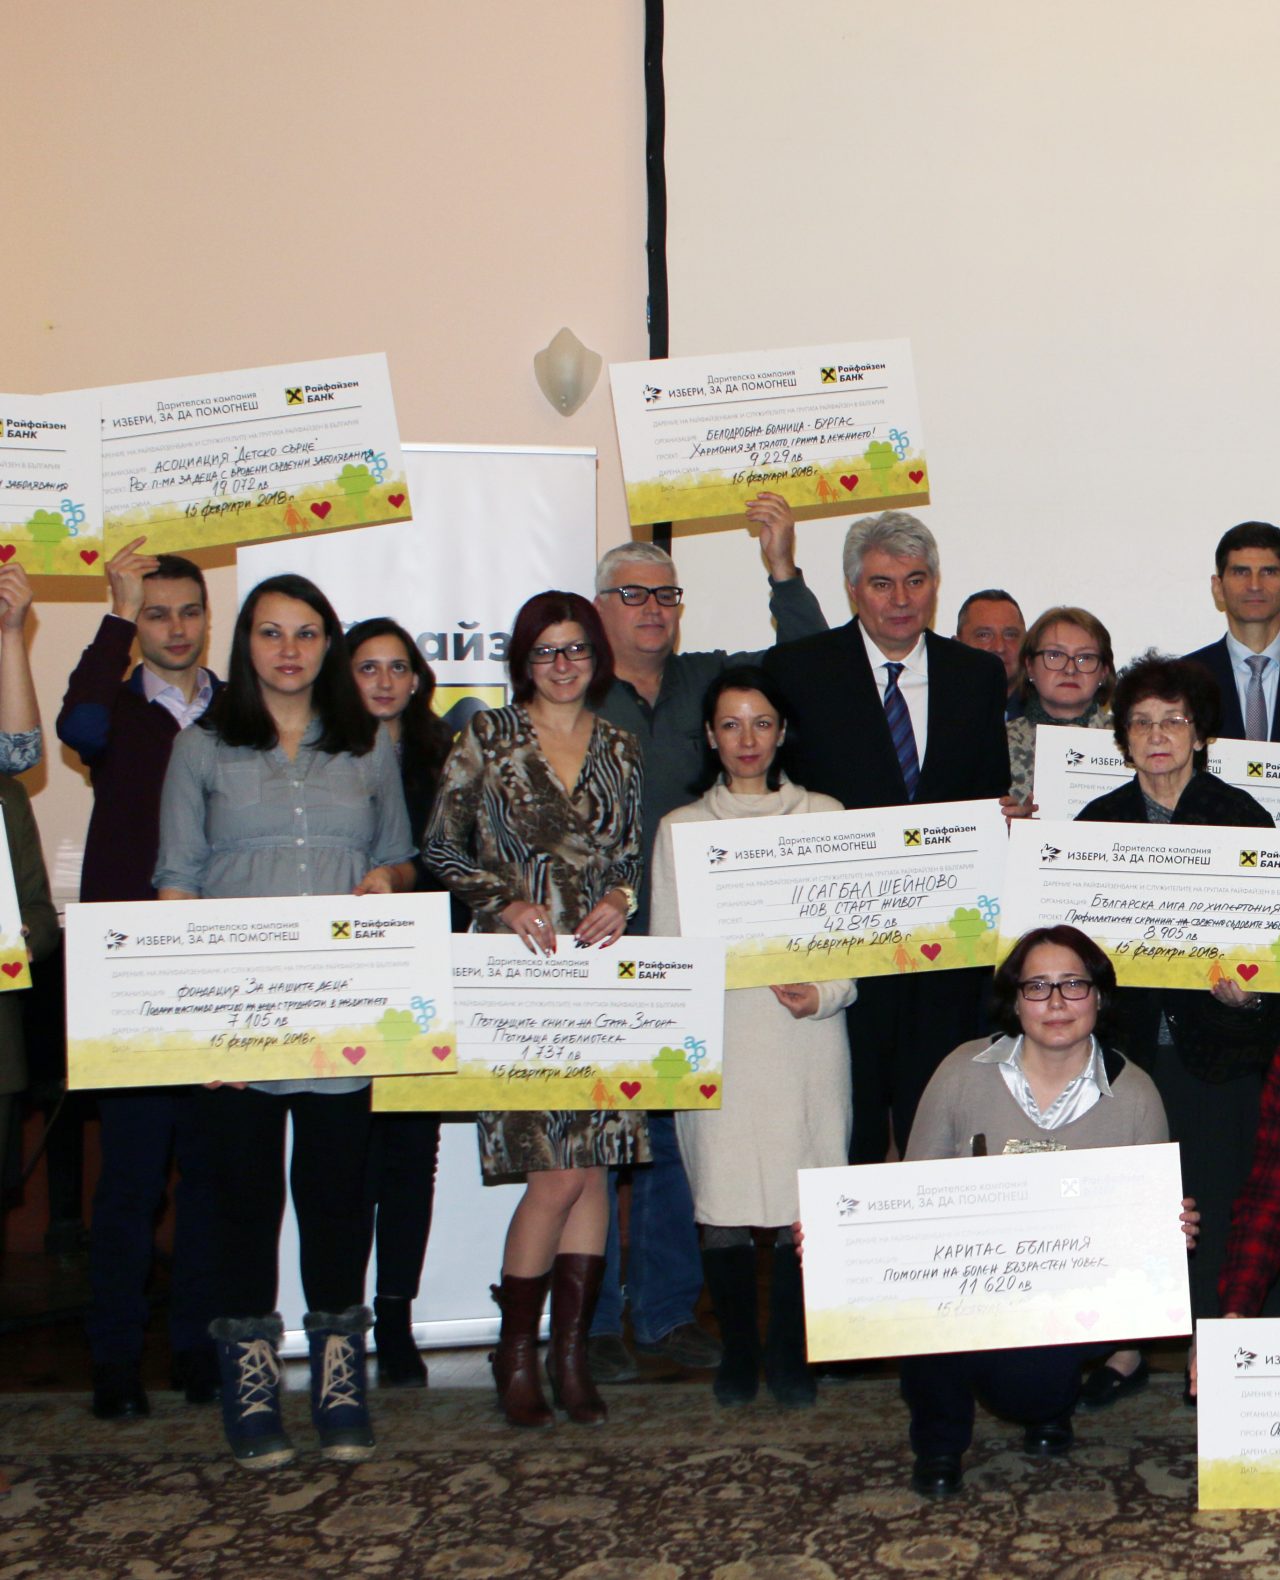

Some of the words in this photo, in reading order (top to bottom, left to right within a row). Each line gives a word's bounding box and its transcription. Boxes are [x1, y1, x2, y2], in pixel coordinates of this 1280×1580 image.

[838, 364, 886, 373] Райфайзен
[707, 374, 756, 385] Дарителска
[757, 370, 796, 379] кампания
[840, 374, 864, 382] БАНК
[304, 381, 359, 393] Райфайзен
[668, 387, 706, 398] ИЗБЕРИ,
[710, 385, 722, 394] ЗА
[725, 384, 739, 394] ДА
[741, 378, 797, 391] ПОМОГНЕШ
[157, 398, 212, 412] Дарителска
[213, 392, 257, 403] кампания
[307, 393, 334, 403] БАНК
[112, 415, 156, 427] ИЗБЕРИ,
[160, 412, 174, 422] ЗА
[178, 410, 193, 421] ДА
[195, 401, 259, 417] ПОМОГНЕШ
[6, 418, 66, 430] Райфайзен
[813, 415, 855, 430] БУРГАС
[7, 430, 37, 439] БАНК
[152, 451, 230, 474] АСОЦИАЦИЯ
[760, 449, 790, 465] 229
[211, 481, 228, 496] 19
[230, 477, 257, 493] 072
[923, 825, 976, 836] Райфайзен
[778, 835, 831, 847] Дарителска
[833, 832, 876, 841] кампания
[924, 836, 951, 845] БАНК
[735, 849, 776, 860] ИЗБЕРИ,
[780, 847, 794, 856] ЗА
[797, 846, 812, 856] ДА
[815, 840, 877, 853] ПОМОГНЕШ
[1112, 842, 1166, 854] Дарителска
[1067, 852, 1108, 862] ИЗБЕРИ,
[1112, 853, 1126, 862] ЗА
[1129, 854, 1144, 864] ДА
[1148, 854, 1211, 866] ПОМОГНЕШ
[798, 903, 827, 918] НОВ
[833, 899, 873, 914] СТАРТ
[880, 895, 930, 909] ЖИВОТ
[187, 922, 248, 934] Дарителска
[250, 922, 299, 930] кампания
[354, 919, 414, 929] Райфайзен
[189, 934, 204, 944] ЗА
[208, 934, 224, 944] ДА
[229, 931, 299, 943] ПОМОГНЕШ
[355, 930, 385, 939] БАНК
[1144, 924, 1155, 940] 8
[1159, 925, 1184, 940] 905
[487, 956, 543, 967] Дарителска
[638, 960, 693, 971] Райфайзен
[488, 968, 501, 977] ЗА
[506, 968, 520, 978] ДА
[525, 968, 588, 978] ПОМОГНЕШ
[638, 971, 666, 979] БАНК
[933, 1240, 1006, 1261] КАРИТАС
[1015, 1235, 1091, 1255] БЪЛГАРИЯ
[942, 1265, 957, 1278] НА
[962, 1262, 998, 1277] БОЛЕН
[983, 1274, 1016, 1293] 620
